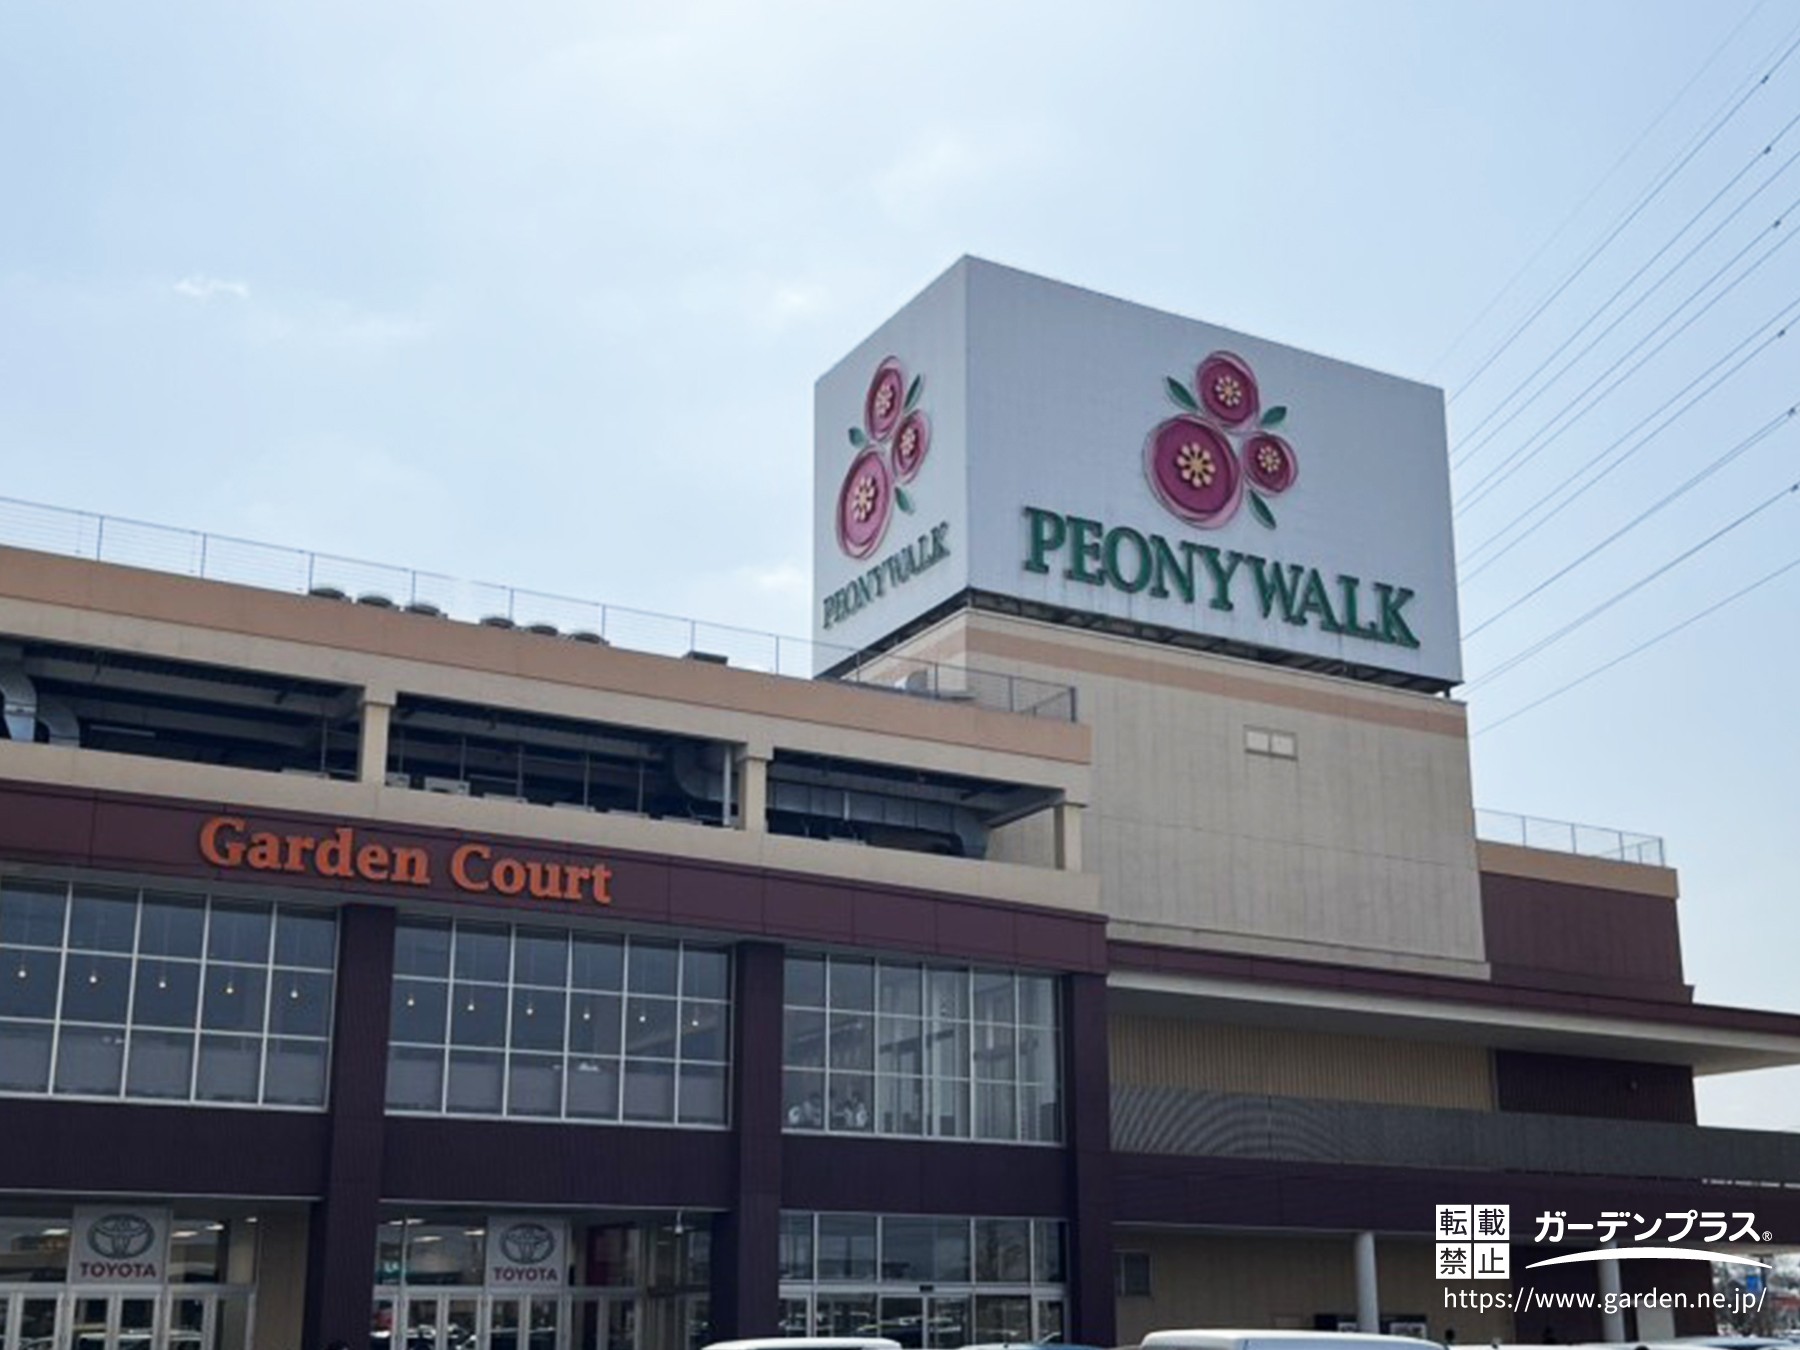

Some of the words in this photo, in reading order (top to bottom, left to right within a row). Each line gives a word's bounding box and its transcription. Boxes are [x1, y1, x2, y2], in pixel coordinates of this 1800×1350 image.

[200, 817, 429, 885] Garden
[451, 843, 611, 903] Court
[80, 1261, 157, 1279] TOYOTA
[493, 1265, 558, 1281] TOYOTA
